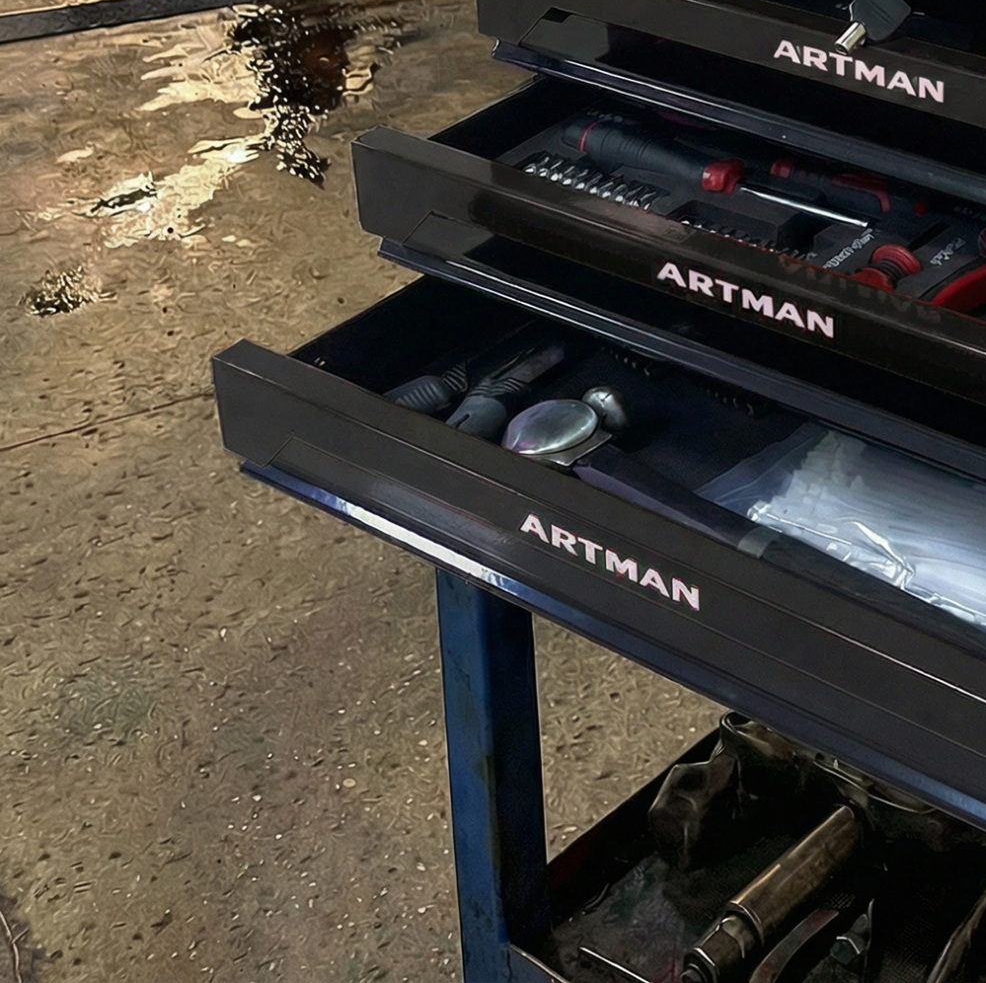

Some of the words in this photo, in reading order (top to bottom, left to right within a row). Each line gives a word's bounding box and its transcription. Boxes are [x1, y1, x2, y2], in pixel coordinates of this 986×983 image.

[773, 40, 944, 103] ARTMAN
[656, 262, 834, 338] ARTMAN
[520, 513, 700, 611] ARTMAN
